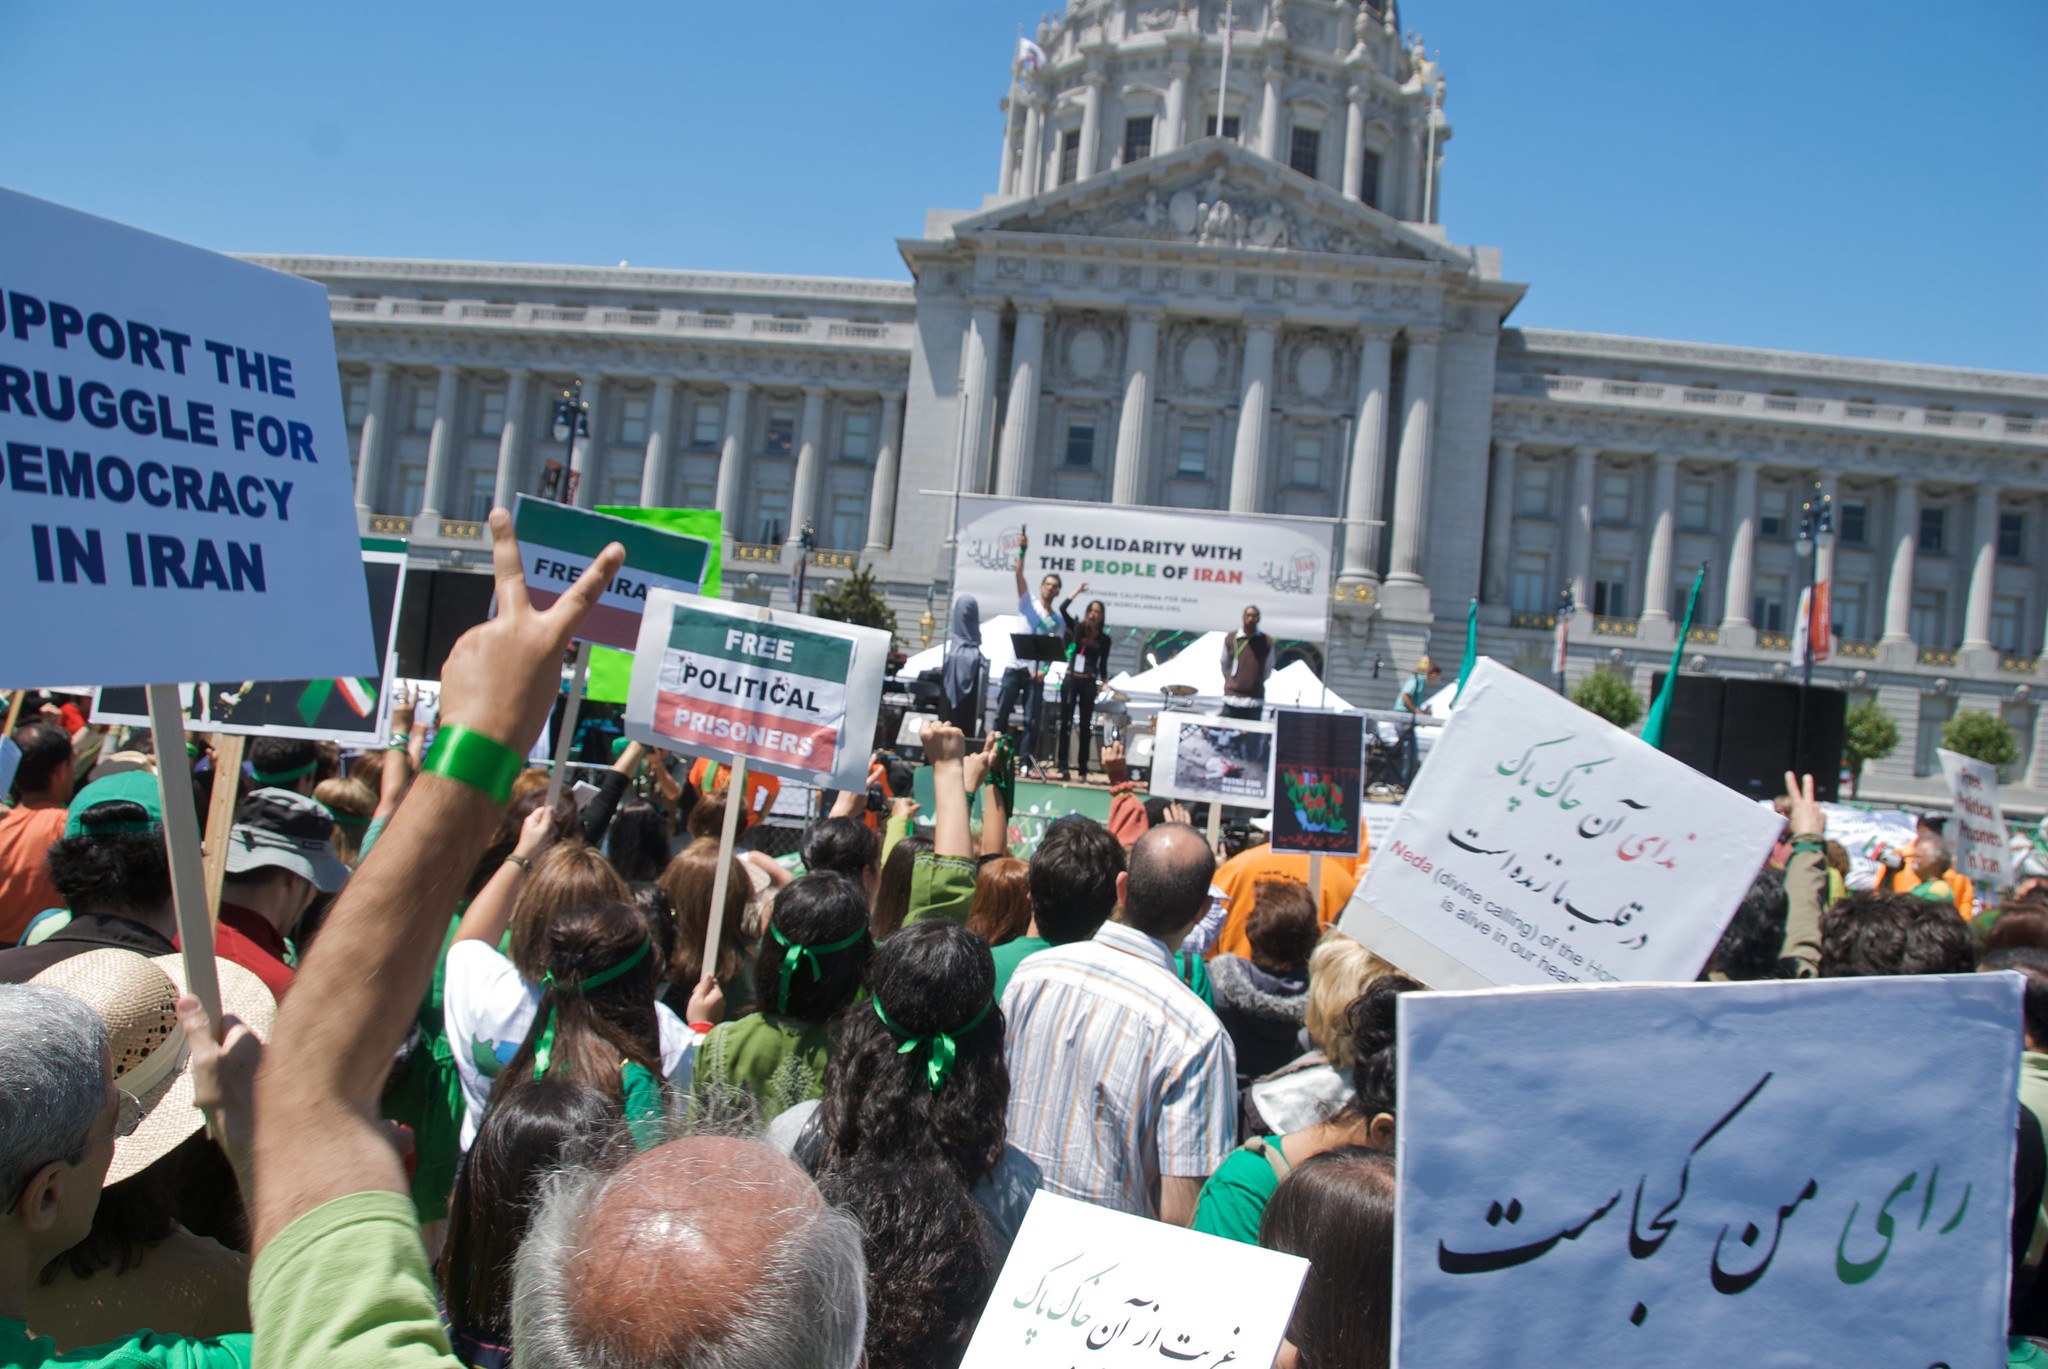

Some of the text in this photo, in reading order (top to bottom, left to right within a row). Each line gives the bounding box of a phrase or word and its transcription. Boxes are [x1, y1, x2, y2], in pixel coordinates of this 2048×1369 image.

[0, 287, 296, 399] PPORT THE
[230, 408, 318, 464] FOR
[0, 441, 294, 521] EMOCRACY
[31, 523, 266, 593] IN IRAN
[1040, 556, 1075, 571] THE
[1081, 559, 1157, 578] PEOPLE
[1162, 565, 1188, 579] OF
[1193, 567, 1243, 584] IRAN
[1044, 533, 1242, 560] IN SOLIDARITY WITH
[533, 557, 647, 601] FRE IRA
[725, 629, 794, 663] FREE
[682, 664, 820, 713] POLITICAL
[673, 708, 813, 757] PRISONERS
[1389, 840, 1433, 874] Neda
[1432, 868, 1483, 905] (divine
[1484, 900, 1539, 941] calling)
[1539, 934, 1559, 950] of
[1558, 943, 1583, 966] the
[1440, 896, 1453, 913] is
[1455, 907, 1491, 935] alive
[1492, 925, 1509, 945] in
[1509, 941, 1538, 962] our
[1710, 1177, 1819, 1296] من
